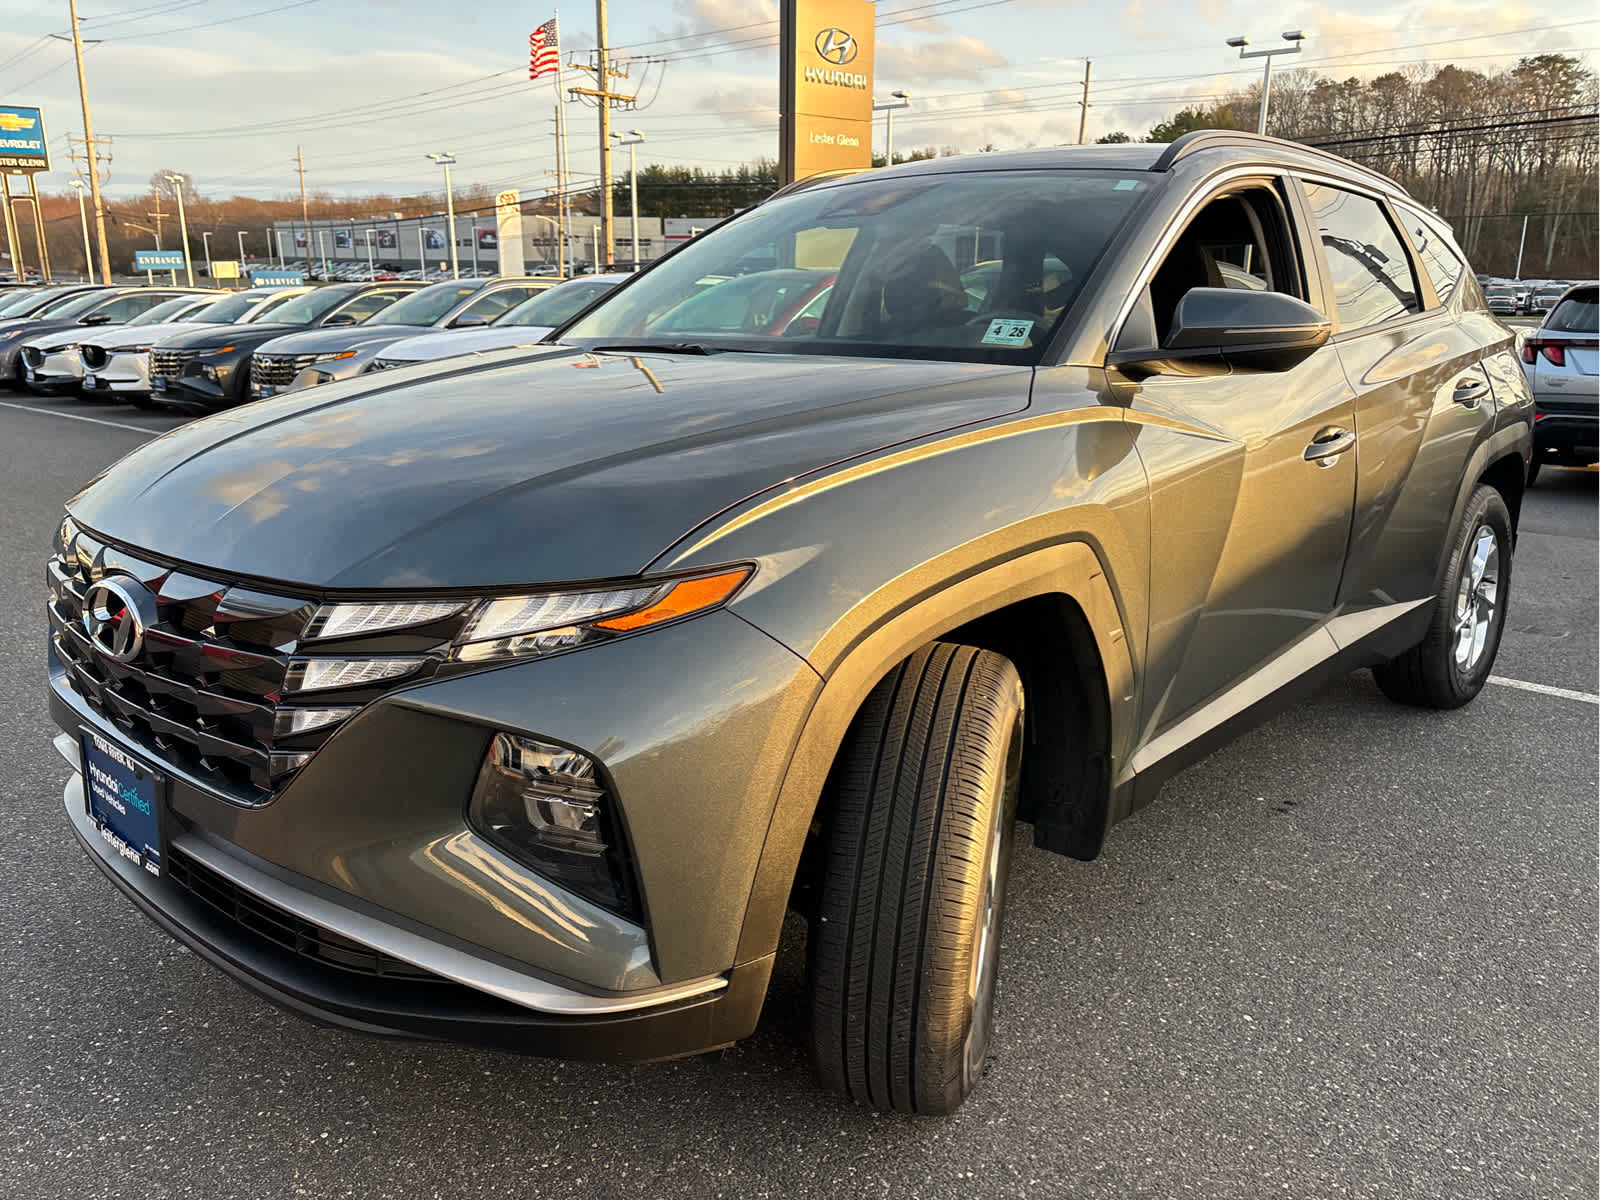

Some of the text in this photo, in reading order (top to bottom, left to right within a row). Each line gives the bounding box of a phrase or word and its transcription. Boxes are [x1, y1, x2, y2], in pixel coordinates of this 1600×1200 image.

[804, 66, 866, 89] HYUNDAI
[809, 130, 860, 147] Lester Glenn
[18, 159, 46, 167] GLENN
[140, 256, 181, 265] ENTRANCE
[264, 277, 301, 286] SERVICE
[993, 326, 1025, 337] 4 28
[92, 779, 106, 799] Used
[105, 792, 127, 816] Vehicles
